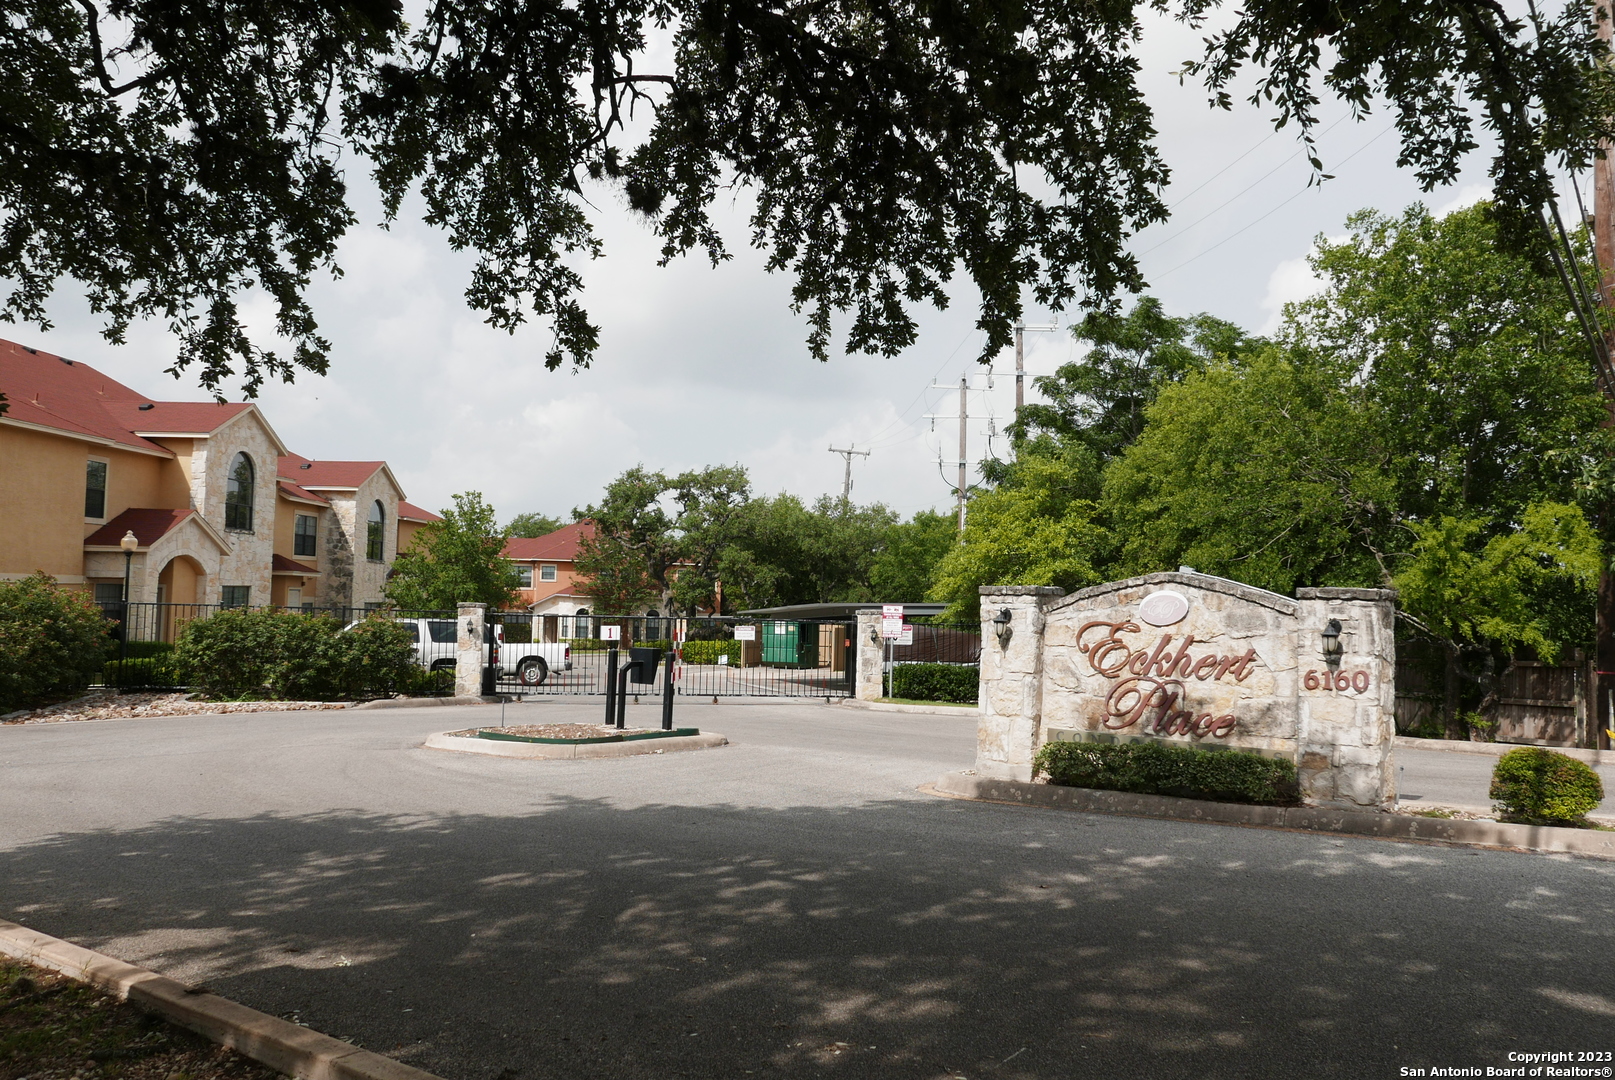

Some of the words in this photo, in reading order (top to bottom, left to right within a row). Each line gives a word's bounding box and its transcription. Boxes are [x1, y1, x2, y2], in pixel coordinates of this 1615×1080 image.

[607, 627, 613, 639] 1
[1075, 620, 1258, 682] Eckhert
[1303, 669, 1370, 694] 6160
[1101, 676, 1237, 739] Place
